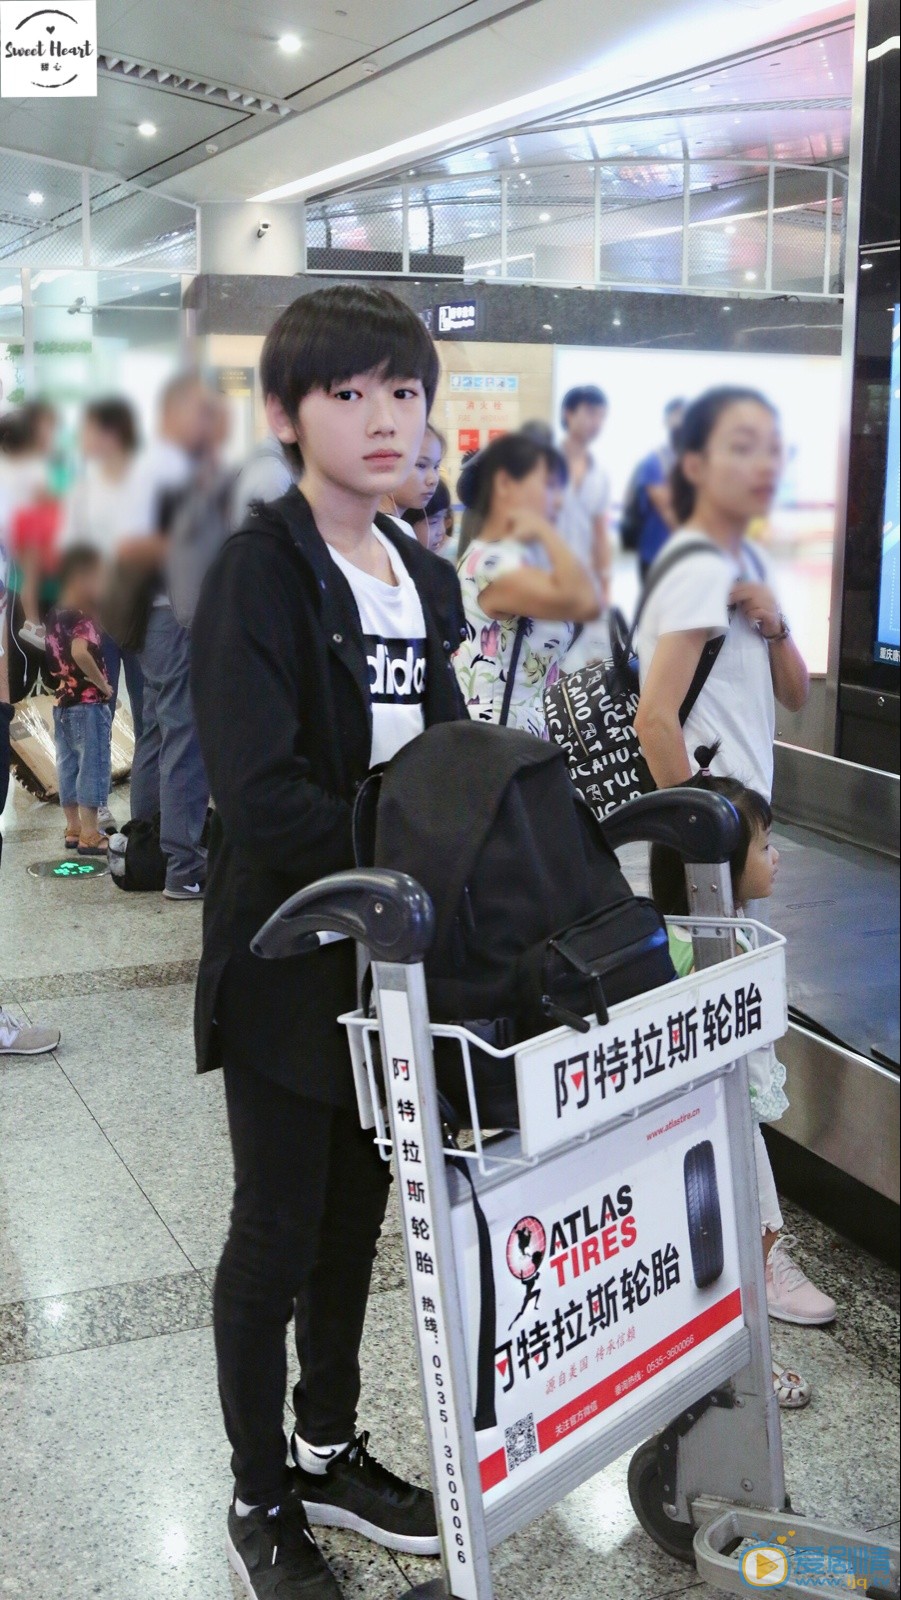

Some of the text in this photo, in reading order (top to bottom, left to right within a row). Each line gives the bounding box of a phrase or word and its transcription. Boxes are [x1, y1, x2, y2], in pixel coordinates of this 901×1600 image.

[554, 983, 762, 1118] 阿特拉斯轮胎
[392, 1057, 435, 1275] 阿特拉斯轮胎
[549, 1184, 633, 1257] ATLAS
[550, 1215, 637, 1288] TIRES
[545, 1355, 589, 1395] 源自美国
[555, 1400, 598, 1437] 关注官方微信
